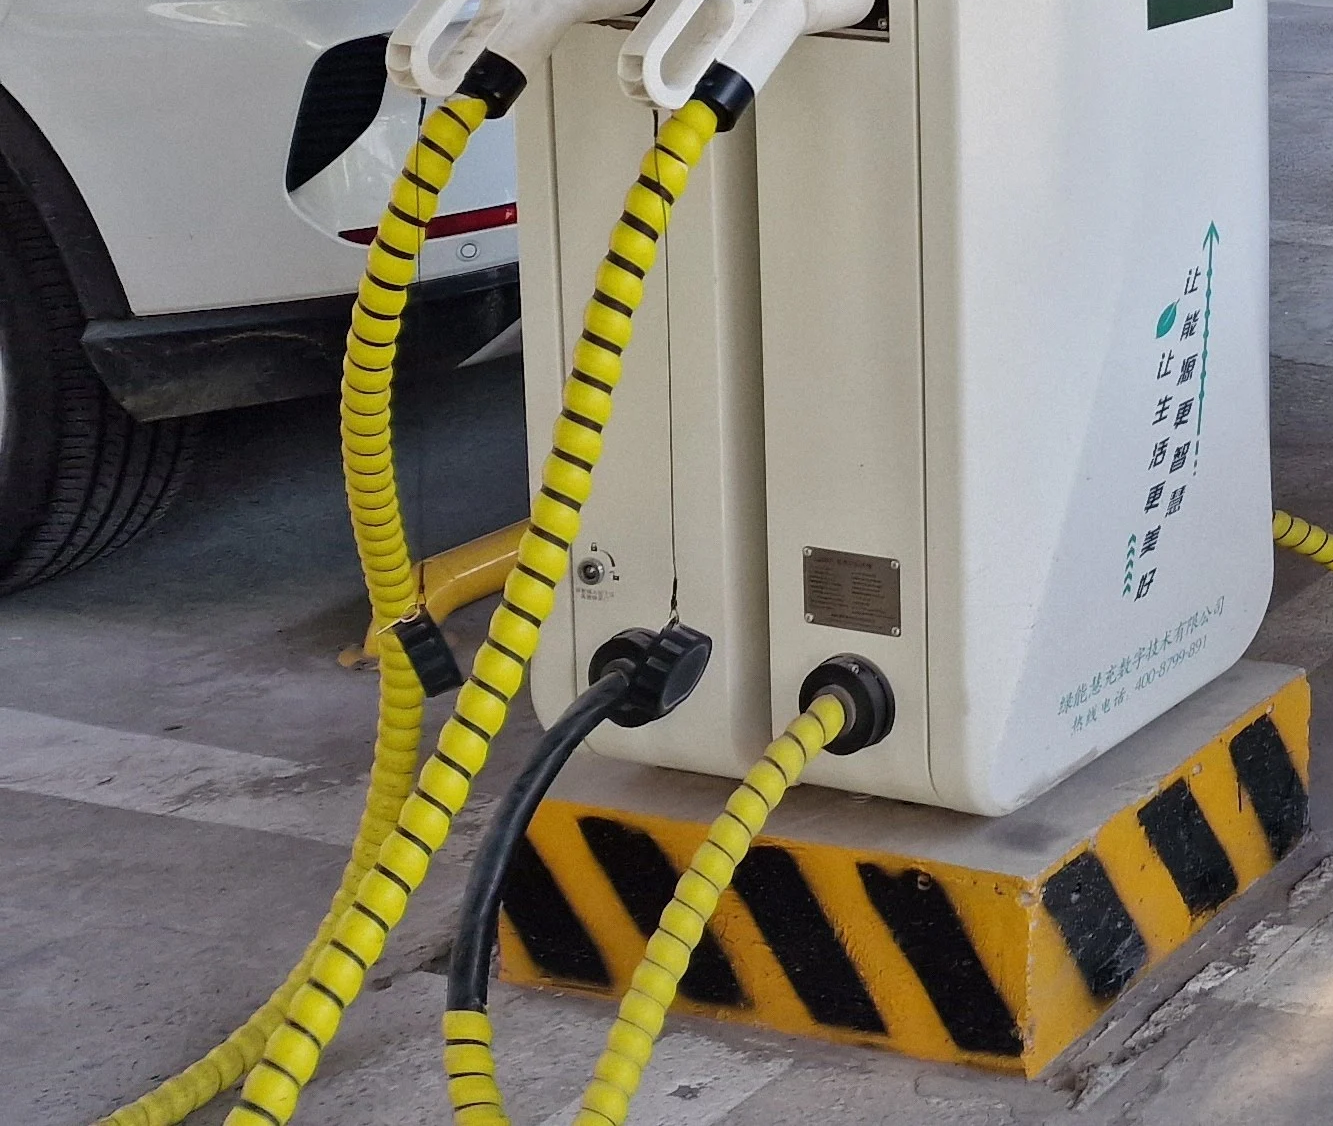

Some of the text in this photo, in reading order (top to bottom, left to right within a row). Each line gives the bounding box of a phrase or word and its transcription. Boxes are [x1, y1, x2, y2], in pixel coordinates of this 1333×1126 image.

[1134, 349, 1174, 602] 让生活更美好
[1165, 265, 1201, 518] 让能源更智慧
